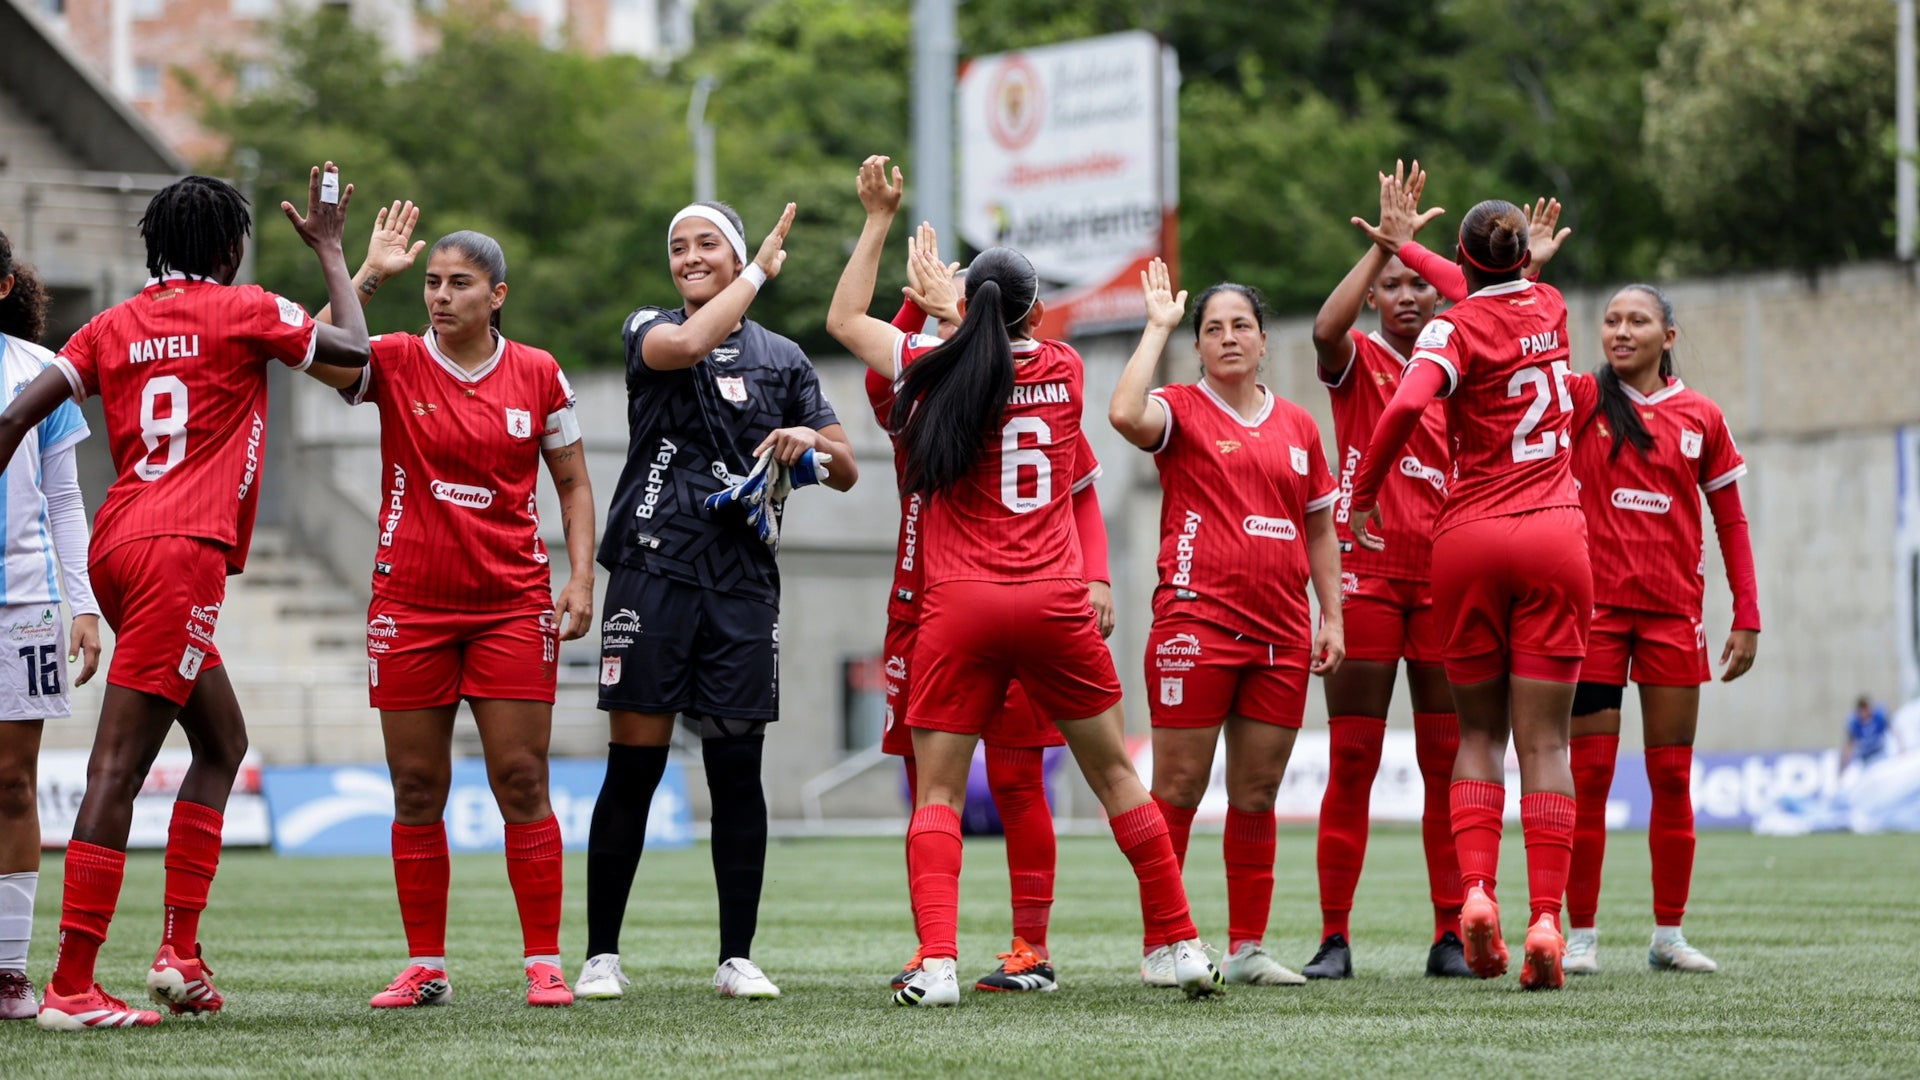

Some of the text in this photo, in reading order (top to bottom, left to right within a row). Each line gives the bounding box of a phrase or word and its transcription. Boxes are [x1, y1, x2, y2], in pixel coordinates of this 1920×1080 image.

[129, 334, 199, 364] NAYELI
[1519, 329, 1559, 356] PAULA
[133, 374, 188, 482] 8
[1006, 383, 1071, 405] RIANA
[237, 410, 263, 500] BetPlay
[432, 483, 490, 505] Colanta
[635, 437, 678, 520] BetPlay
[1001, 416, 1052, 514] 6
[1335, 445, 1362, 524] BetPlay
[380, 462, 406, 547] BetPlay
[901, 492, 922, 572] BetPlay
[1171, 509, 1202, 586] BetPlay
[603, 620, 642, 633] Electrolit
[19, 644, 61, 697] 16
